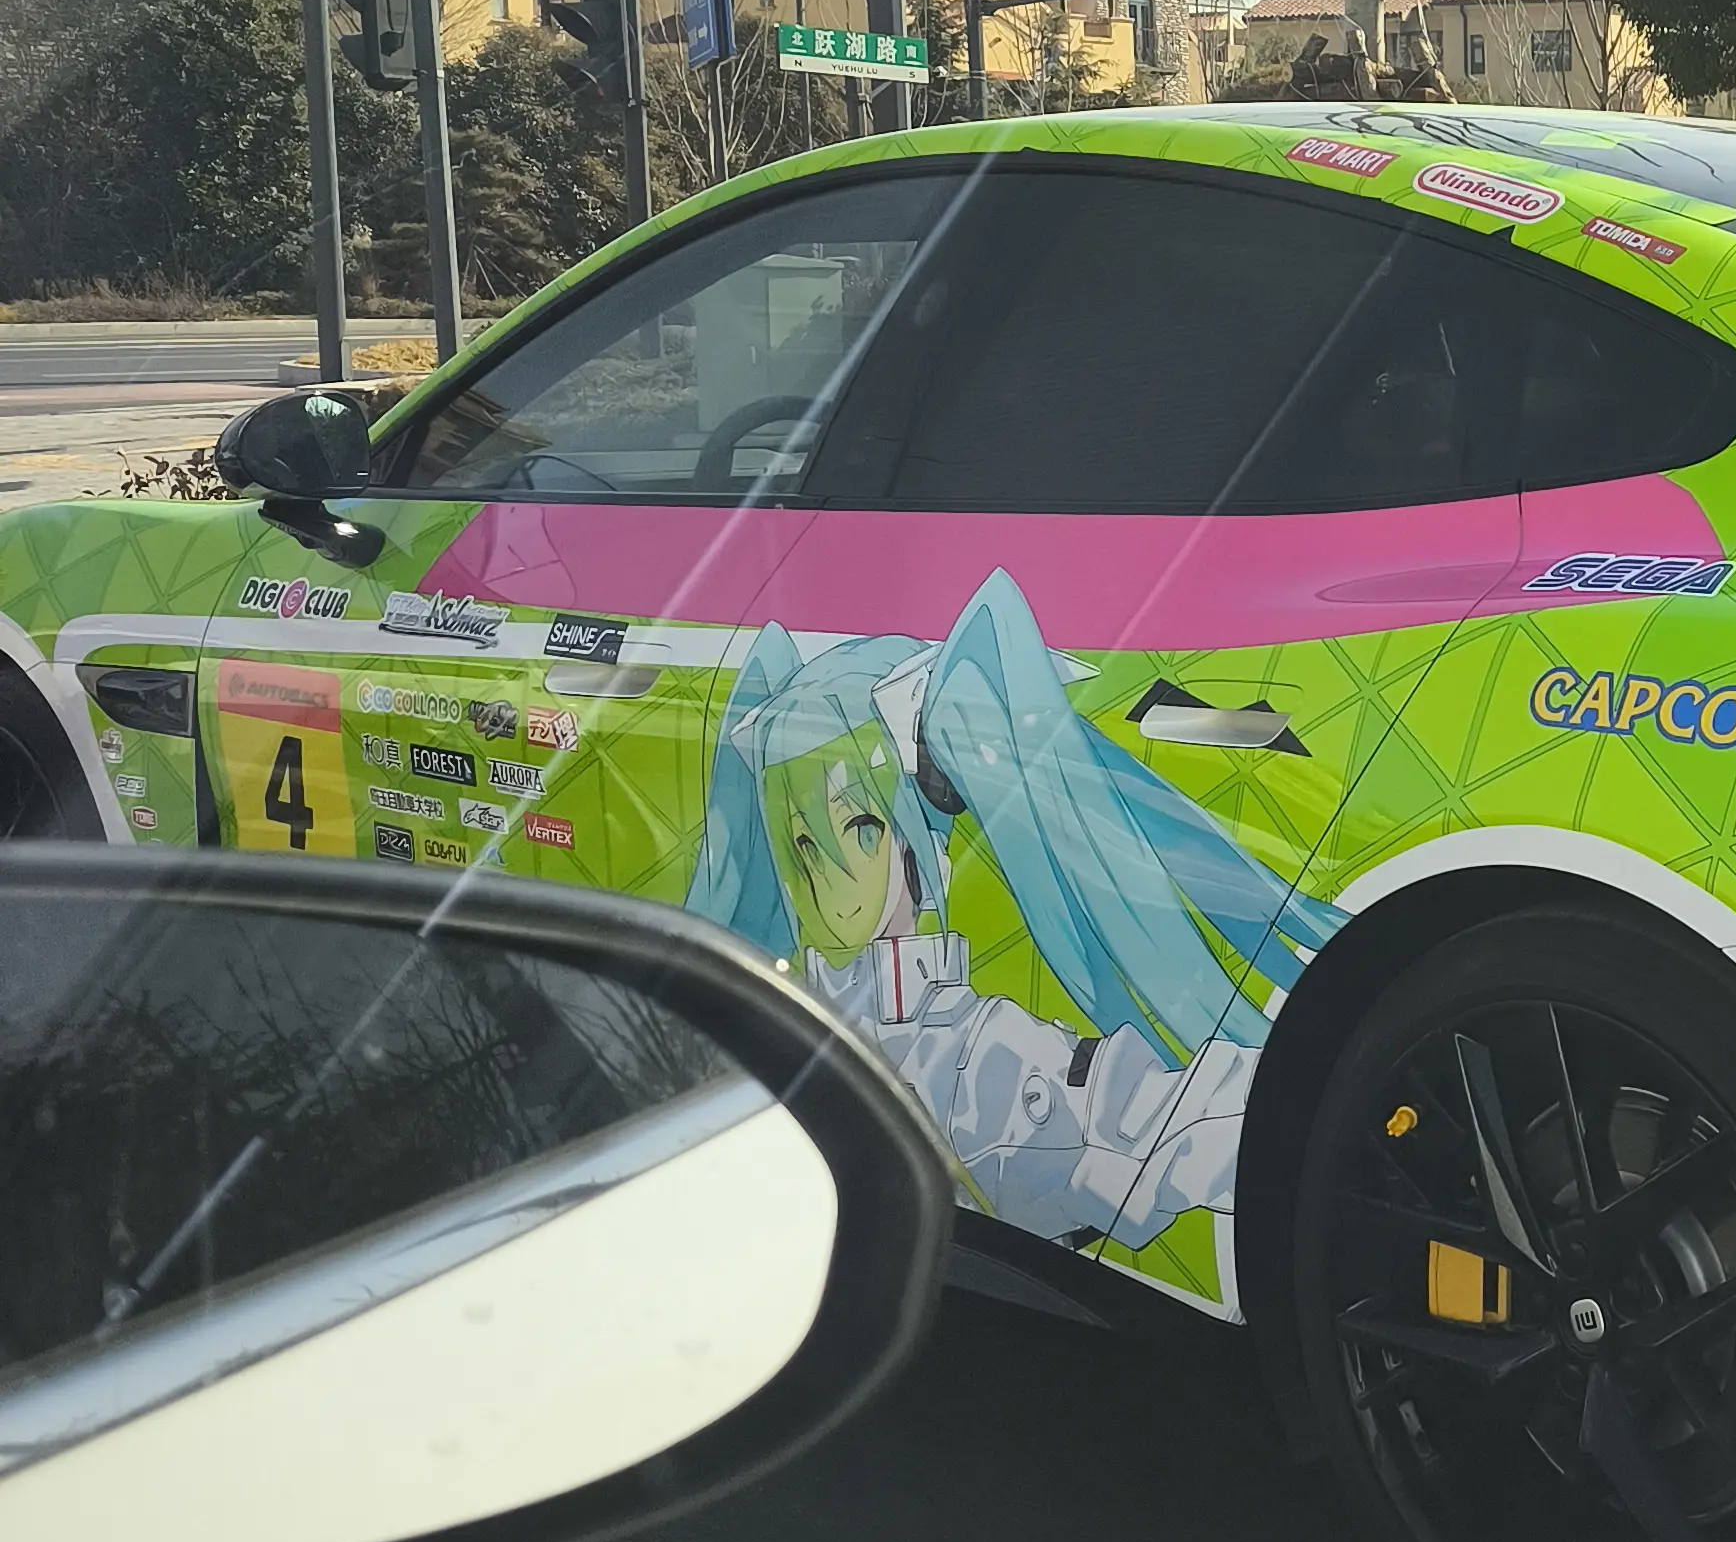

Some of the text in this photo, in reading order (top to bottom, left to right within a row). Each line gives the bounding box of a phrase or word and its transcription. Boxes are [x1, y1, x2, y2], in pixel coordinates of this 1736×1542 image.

[814, 29, 898, 63] 跃湖路
[794, 59, 916, 79] N YUEHU LU S
[1291, 139, 1393, 173] POP MART
[1429, 169, 1541, 211] Nintendo
[1524, 553, 1736, 595] SEGA
[240, 579, 286, 610] DIGI
[303, 588, 350, 619] CLUB
[550, 622, 599, 647] SHINE
[413, 748, 464, 777] FOREST
[488, 759, 546, 793] AURORA
[265, 736, 313, 850] 4
[527, 816, 573, 845] VERTEX
